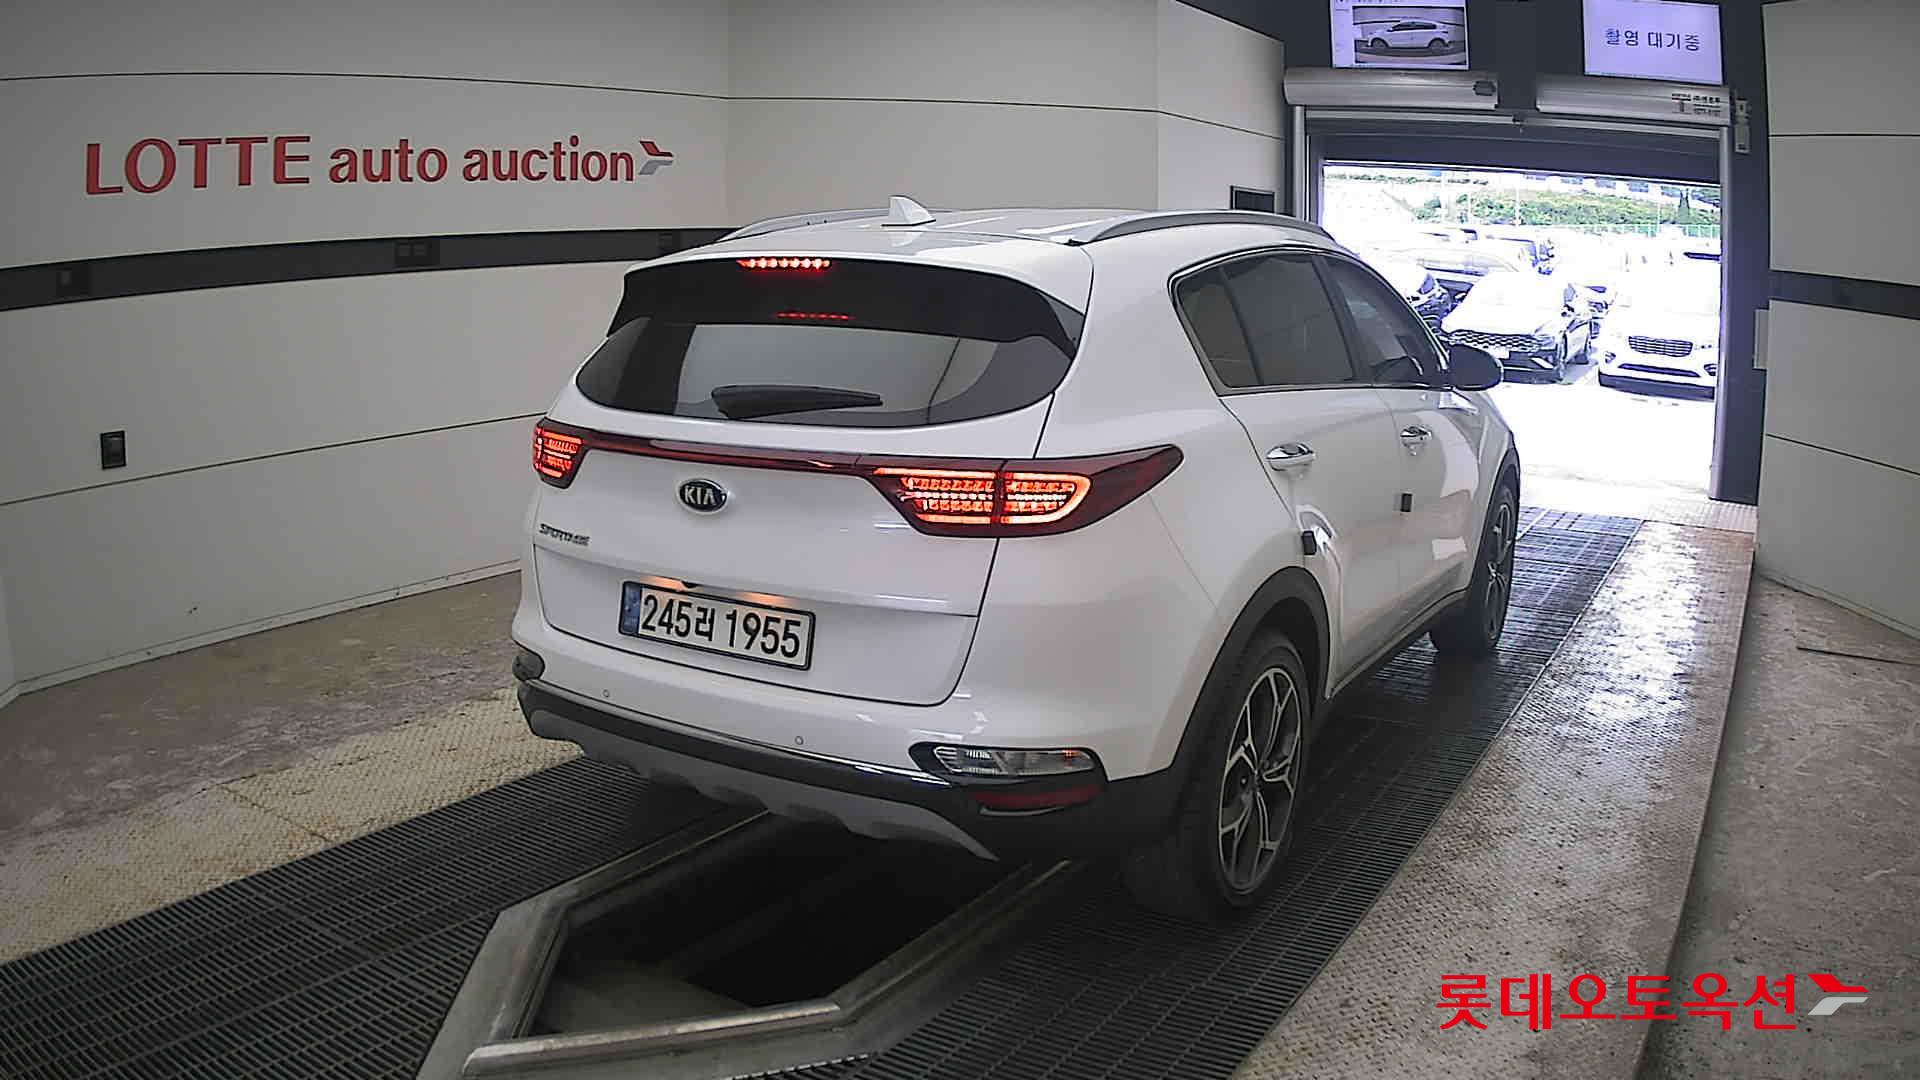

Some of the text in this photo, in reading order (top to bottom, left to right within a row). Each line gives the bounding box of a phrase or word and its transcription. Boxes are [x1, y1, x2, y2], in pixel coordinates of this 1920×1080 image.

[1647, 31, 1701, 52] 대기중
[85, 135, 635, 196] LOTTE auto auction
[683, 485, 717, 504] KIA
[640, 594, 802, 659] 245러 1955
